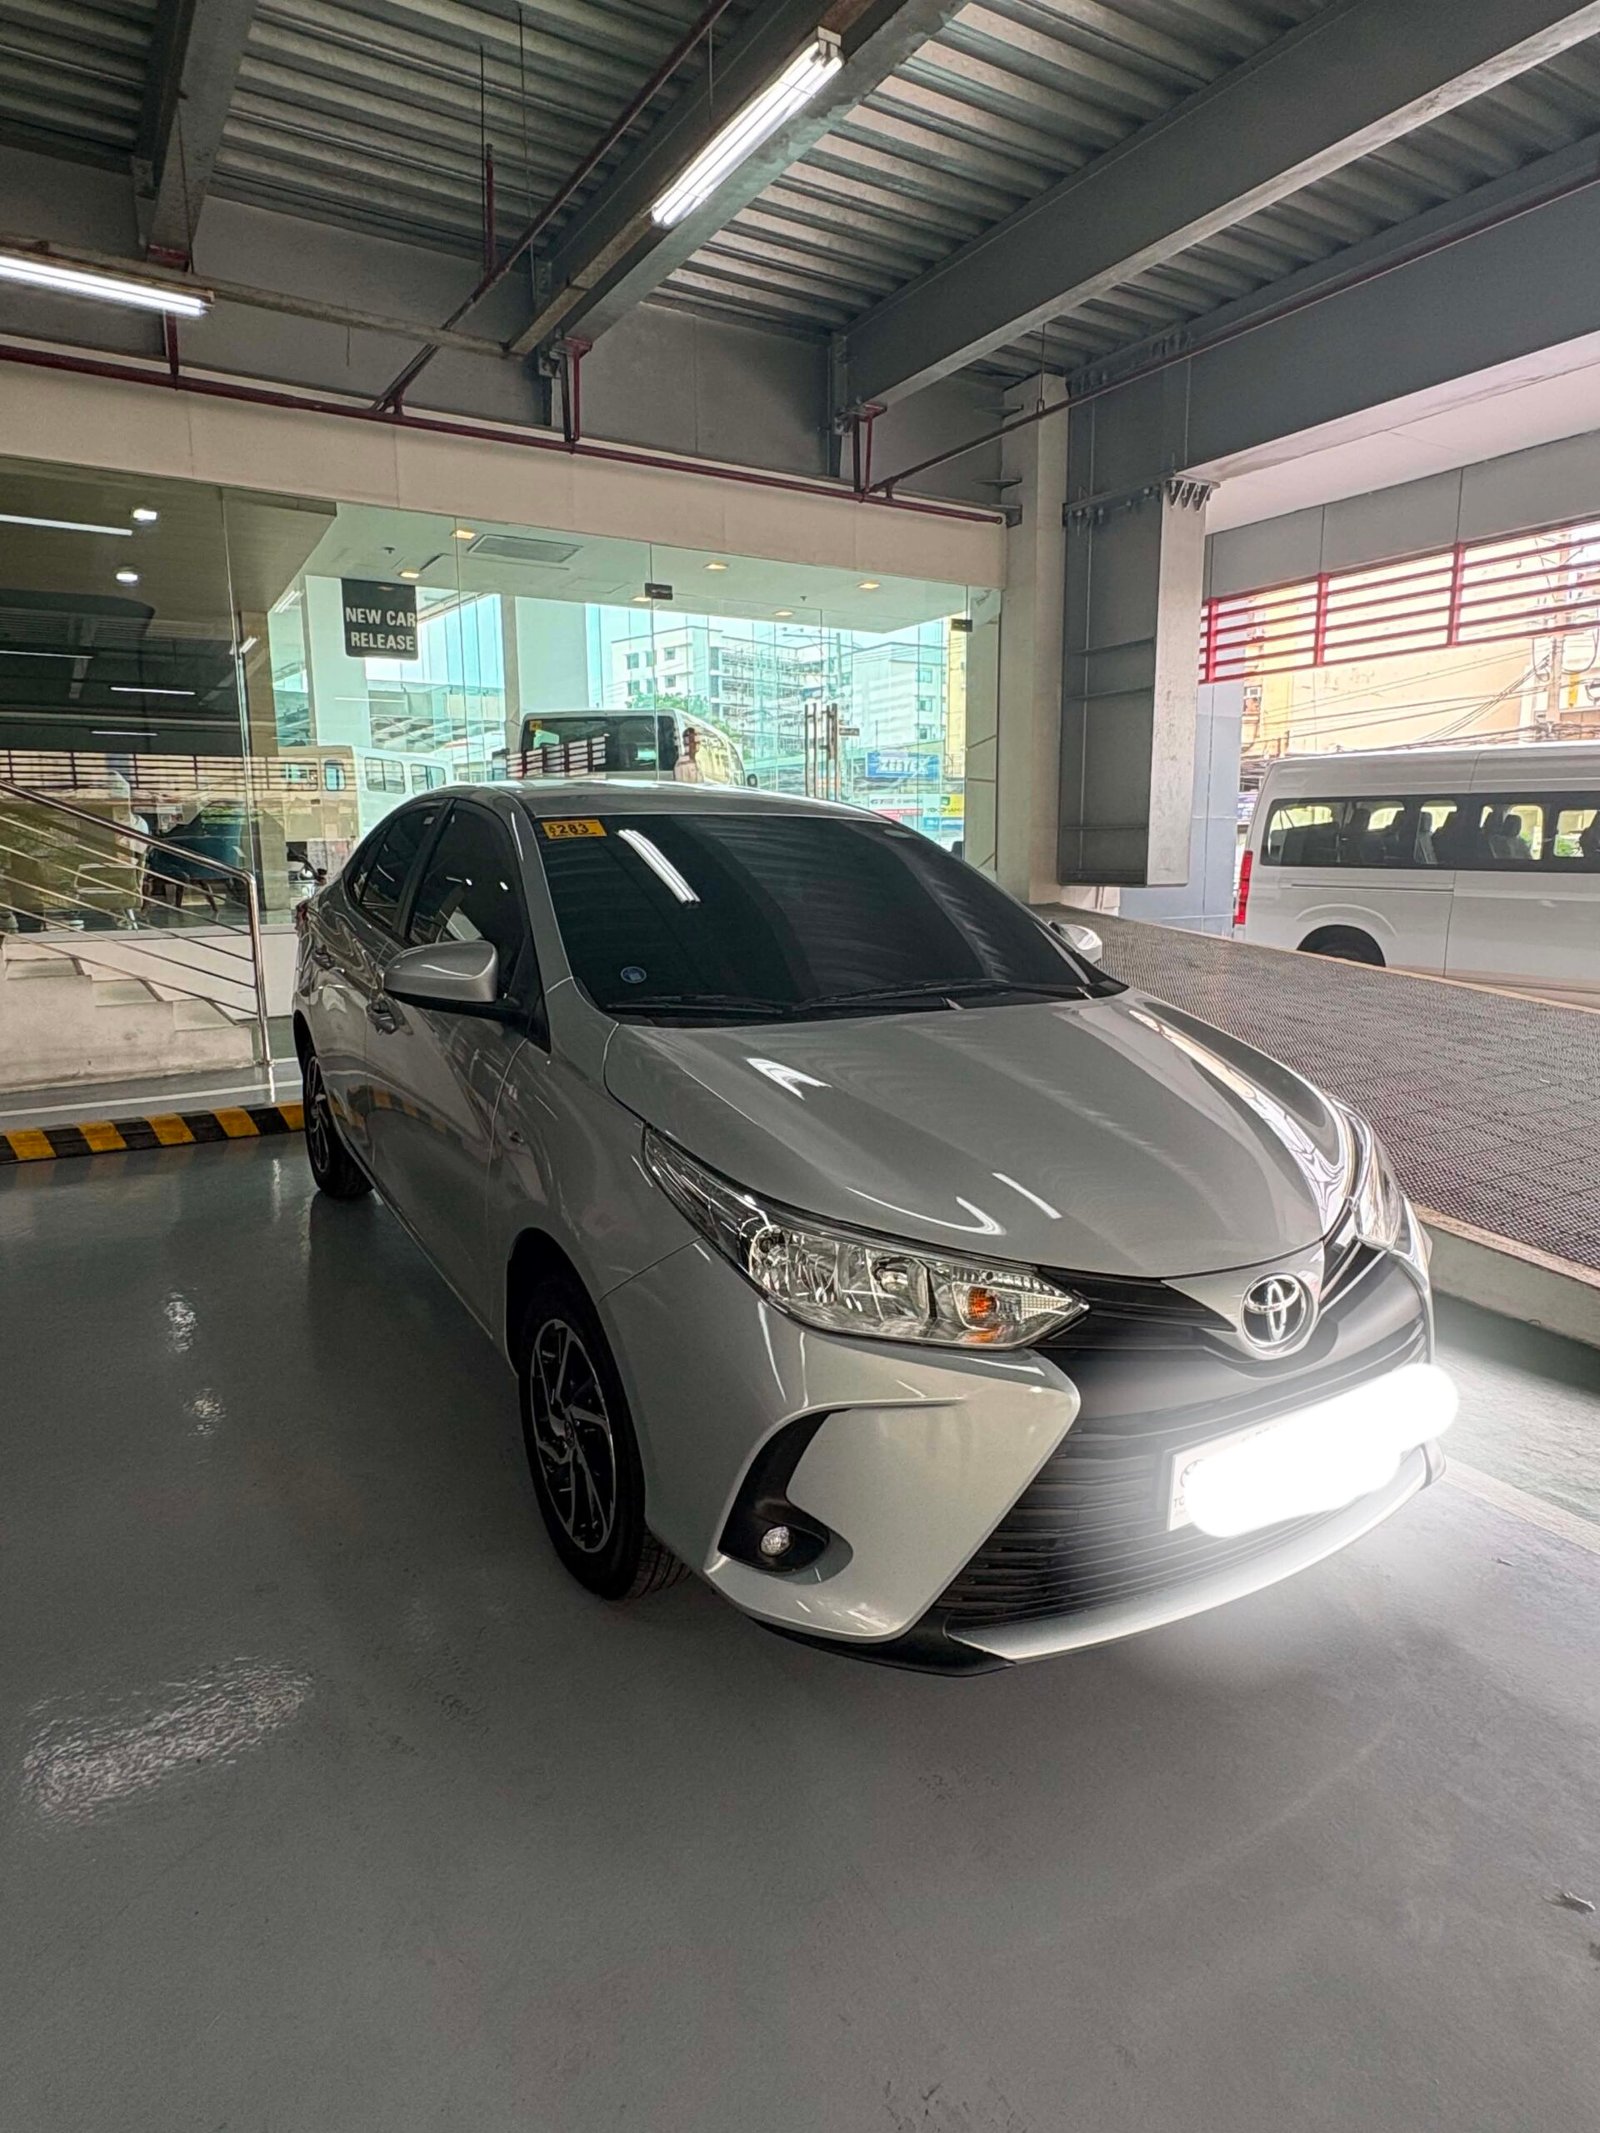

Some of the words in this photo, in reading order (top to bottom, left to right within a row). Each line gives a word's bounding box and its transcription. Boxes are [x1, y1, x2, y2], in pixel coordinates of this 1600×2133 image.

[345, 607, 381, 624] NEW
[386, 611, 416, 627] CAR
[350, 631, 415, 651] RELEASE
